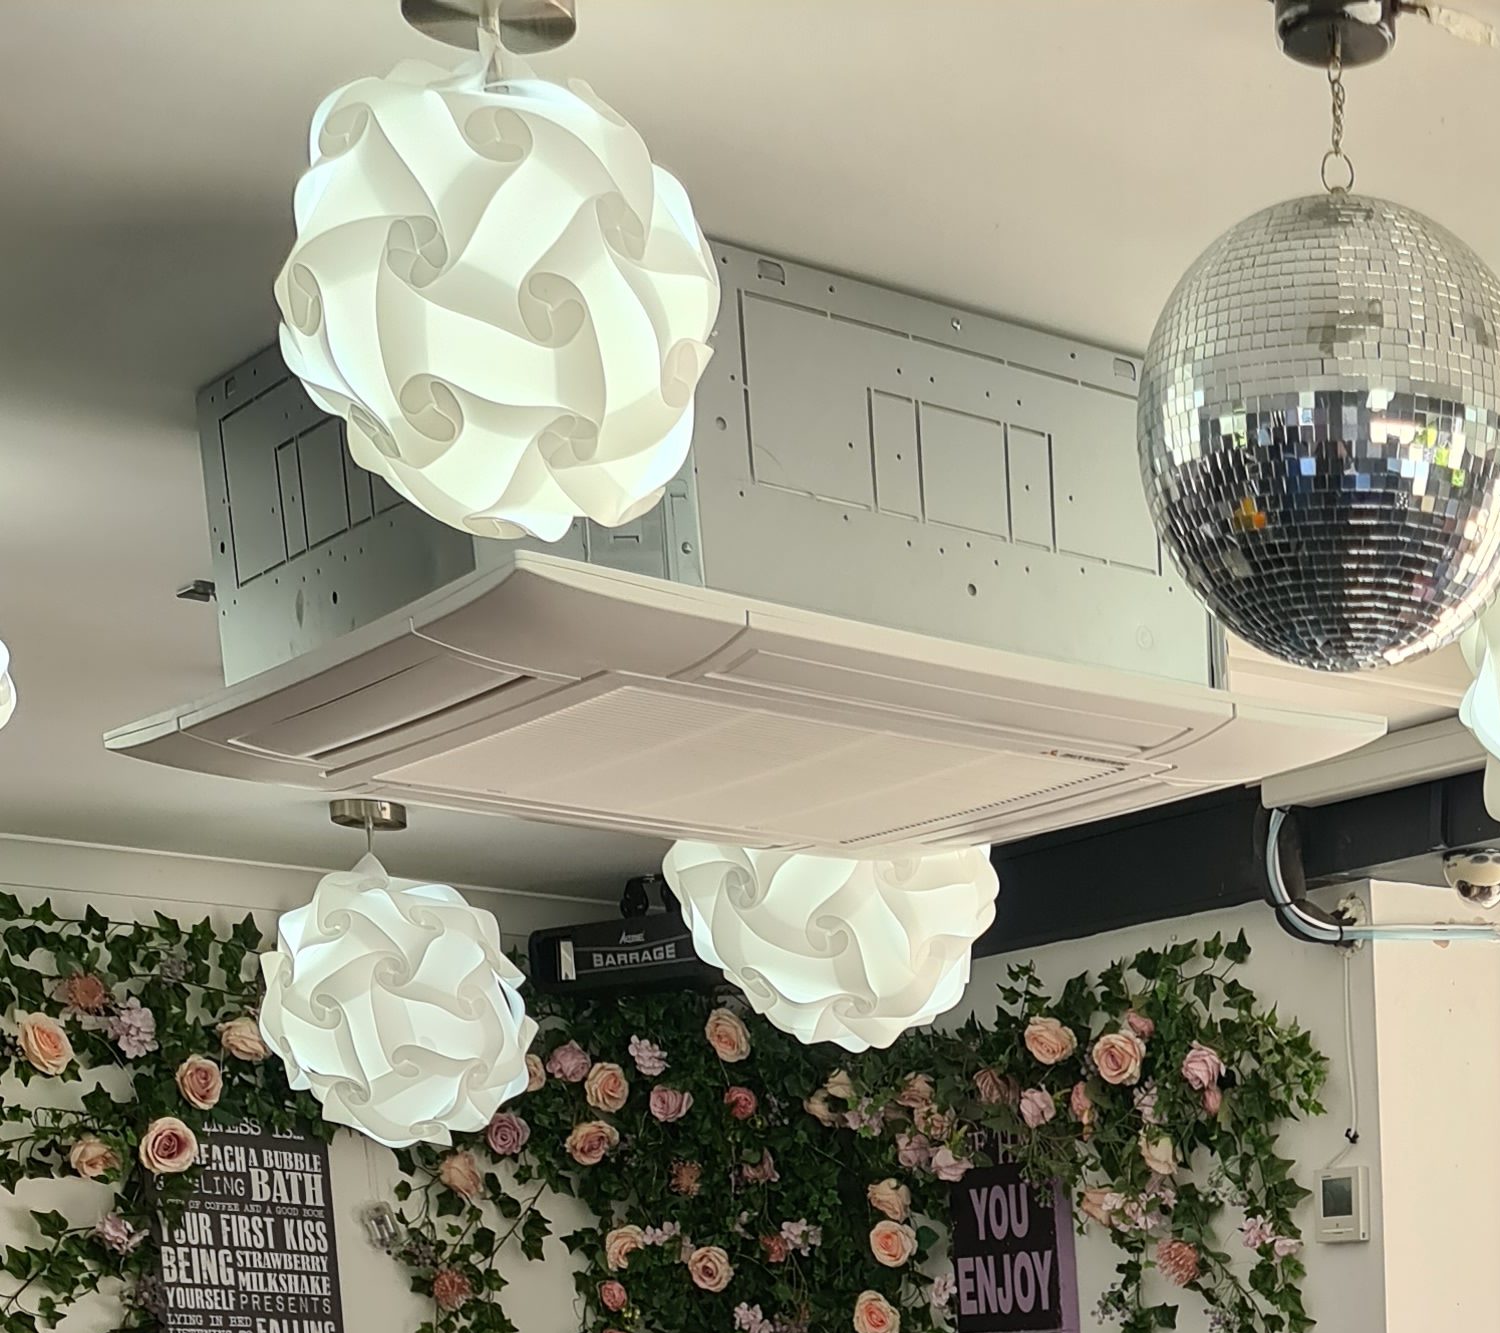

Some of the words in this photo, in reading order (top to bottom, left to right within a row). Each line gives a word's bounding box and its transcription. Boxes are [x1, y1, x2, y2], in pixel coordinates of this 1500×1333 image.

[592, 943, 676, 968] BARRAGE
[193, 1144, 247, 1173] EACH
[248, 1148, 259, 1167] A
[262, 1149, 321, 1173] BUBBLE
[249, 1168, 325, 1207] BATH
[204, 1201, 240, 1212] COFFEE
[244, 1203, 262, 1213] AND
[265, 1205, 273, 1215] A
[275, 1206, 299, 1216] GOOD
[969, 1183, 1029, 1241] YOU
[220, 1213, 275, 1249] FIRST
[283, 1218, 328, 1253] KISS
[161, 1246, 235, 1286] BEING
[235, 1250, 328, 1272] STRAWBERRY
[237, 1271, 331, 1296] MILKSHAKE
[957, 1250, 1053, 1315] ENJOY
[166, 1287, 236, 1310] YOURSELF
[240, 1294, 331, 1314] PRESENTS
[167, 1314, 203, 1325] LYING
[209, 1315, 223, 1326] IN
[228, 1316, 252, 1327] BED
